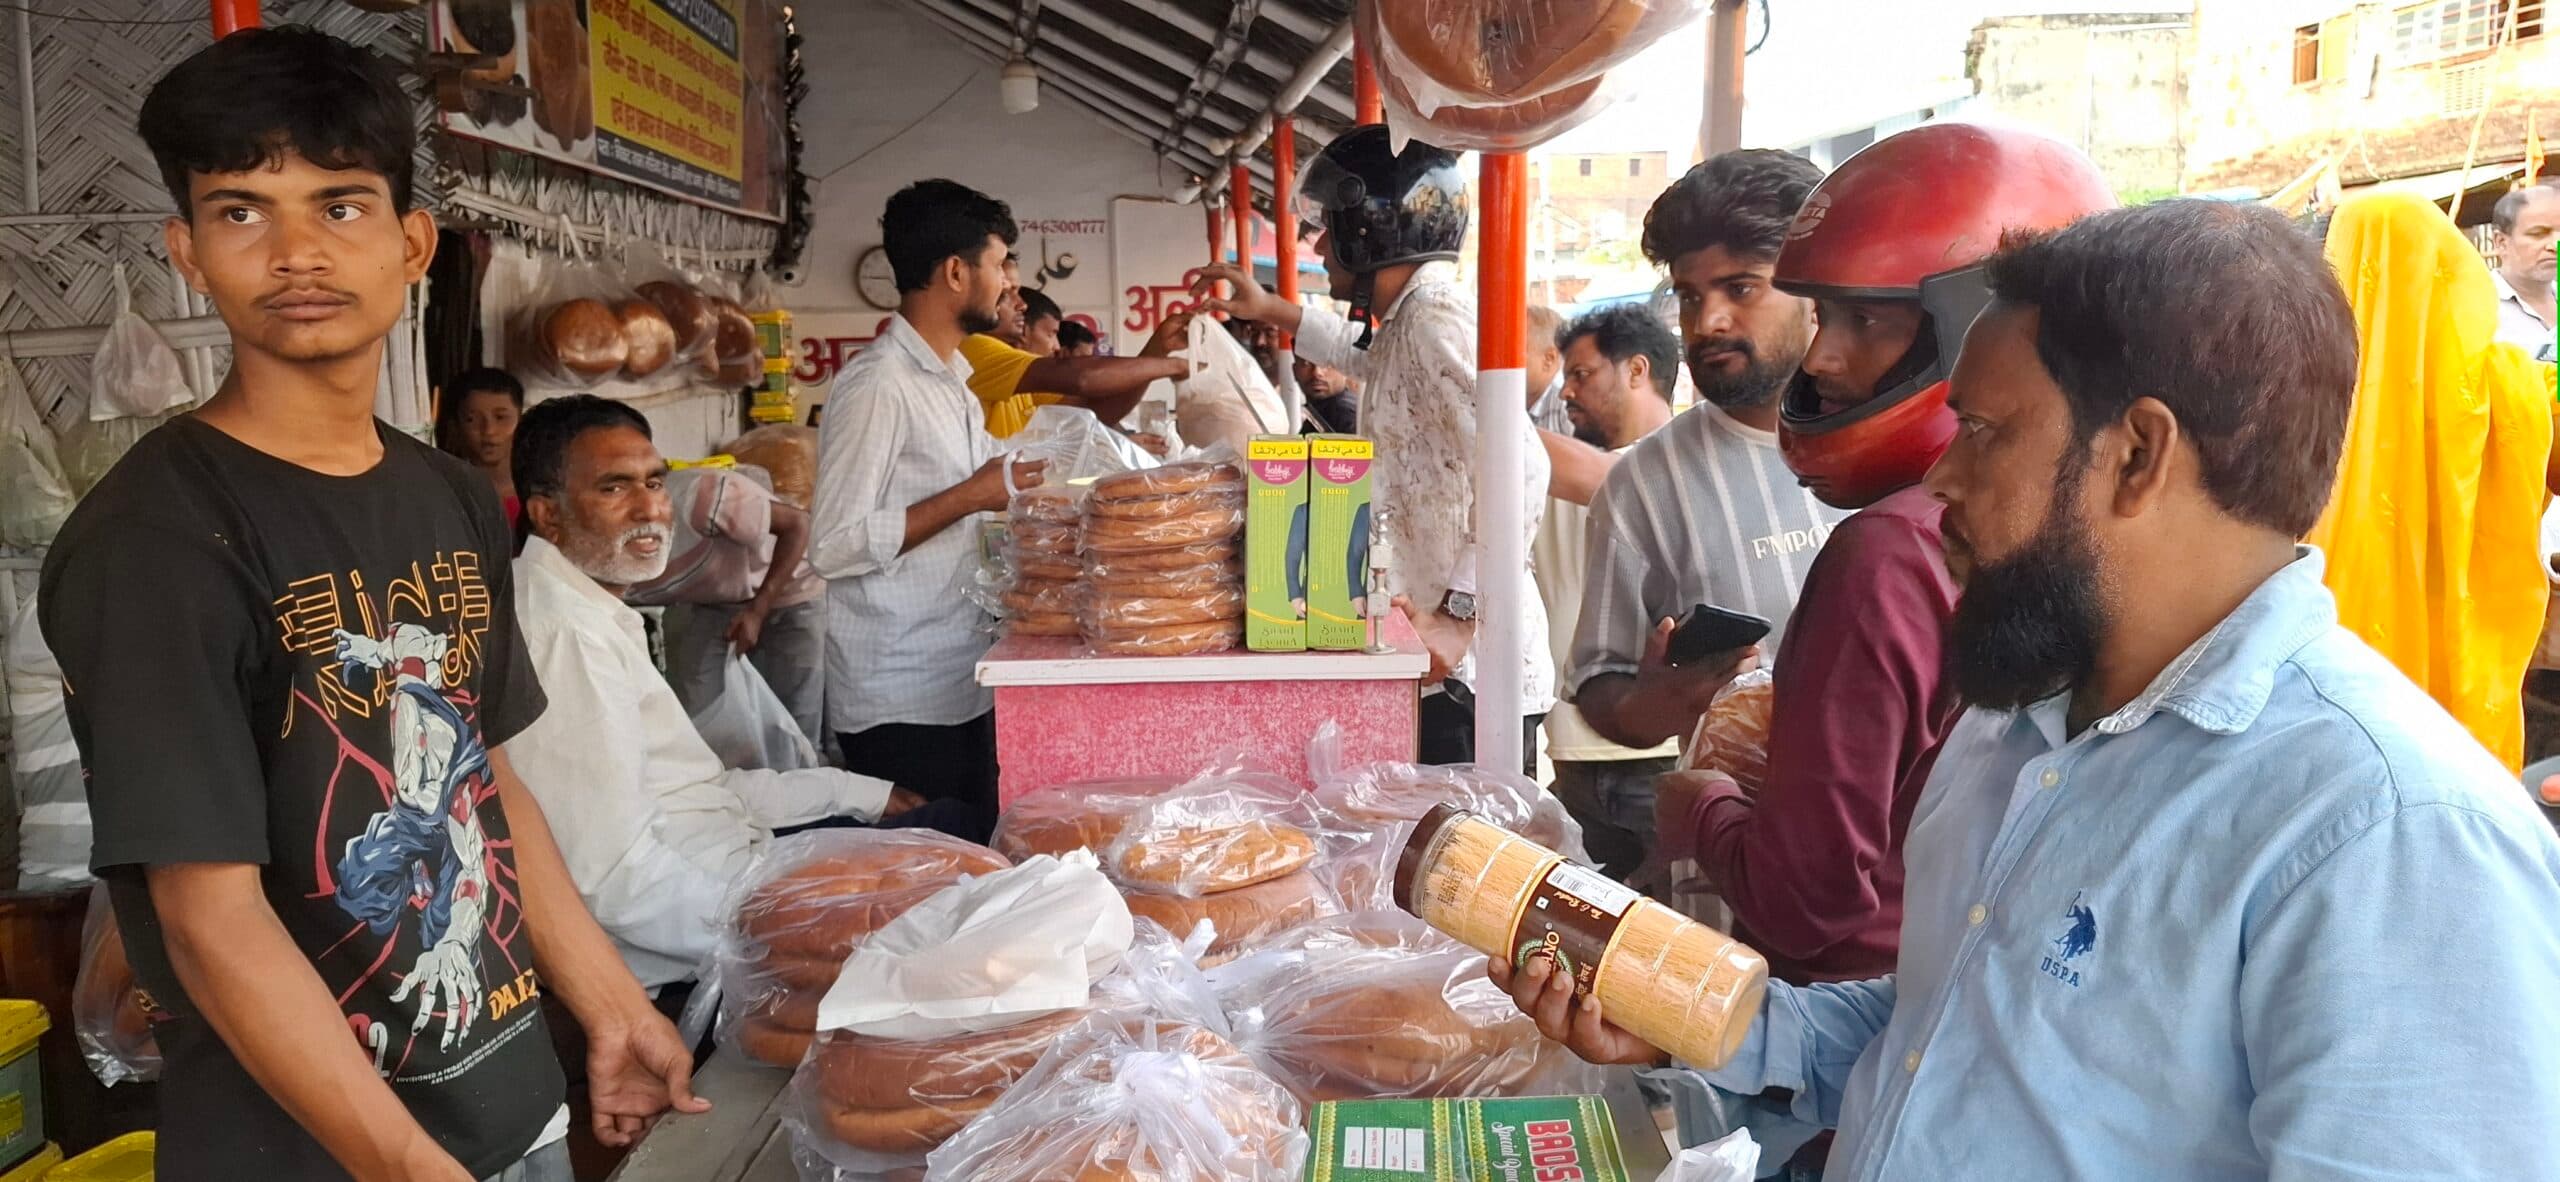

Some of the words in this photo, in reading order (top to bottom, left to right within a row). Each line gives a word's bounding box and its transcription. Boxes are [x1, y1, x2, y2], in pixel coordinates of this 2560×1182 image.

[1021, 220, 1105, 233] 7463001777
[2041, 956, 2080, 987] USPA
[1491, 1121, 1521, 1157] Special
[1524, 1119, 1584, 1182] BADS
